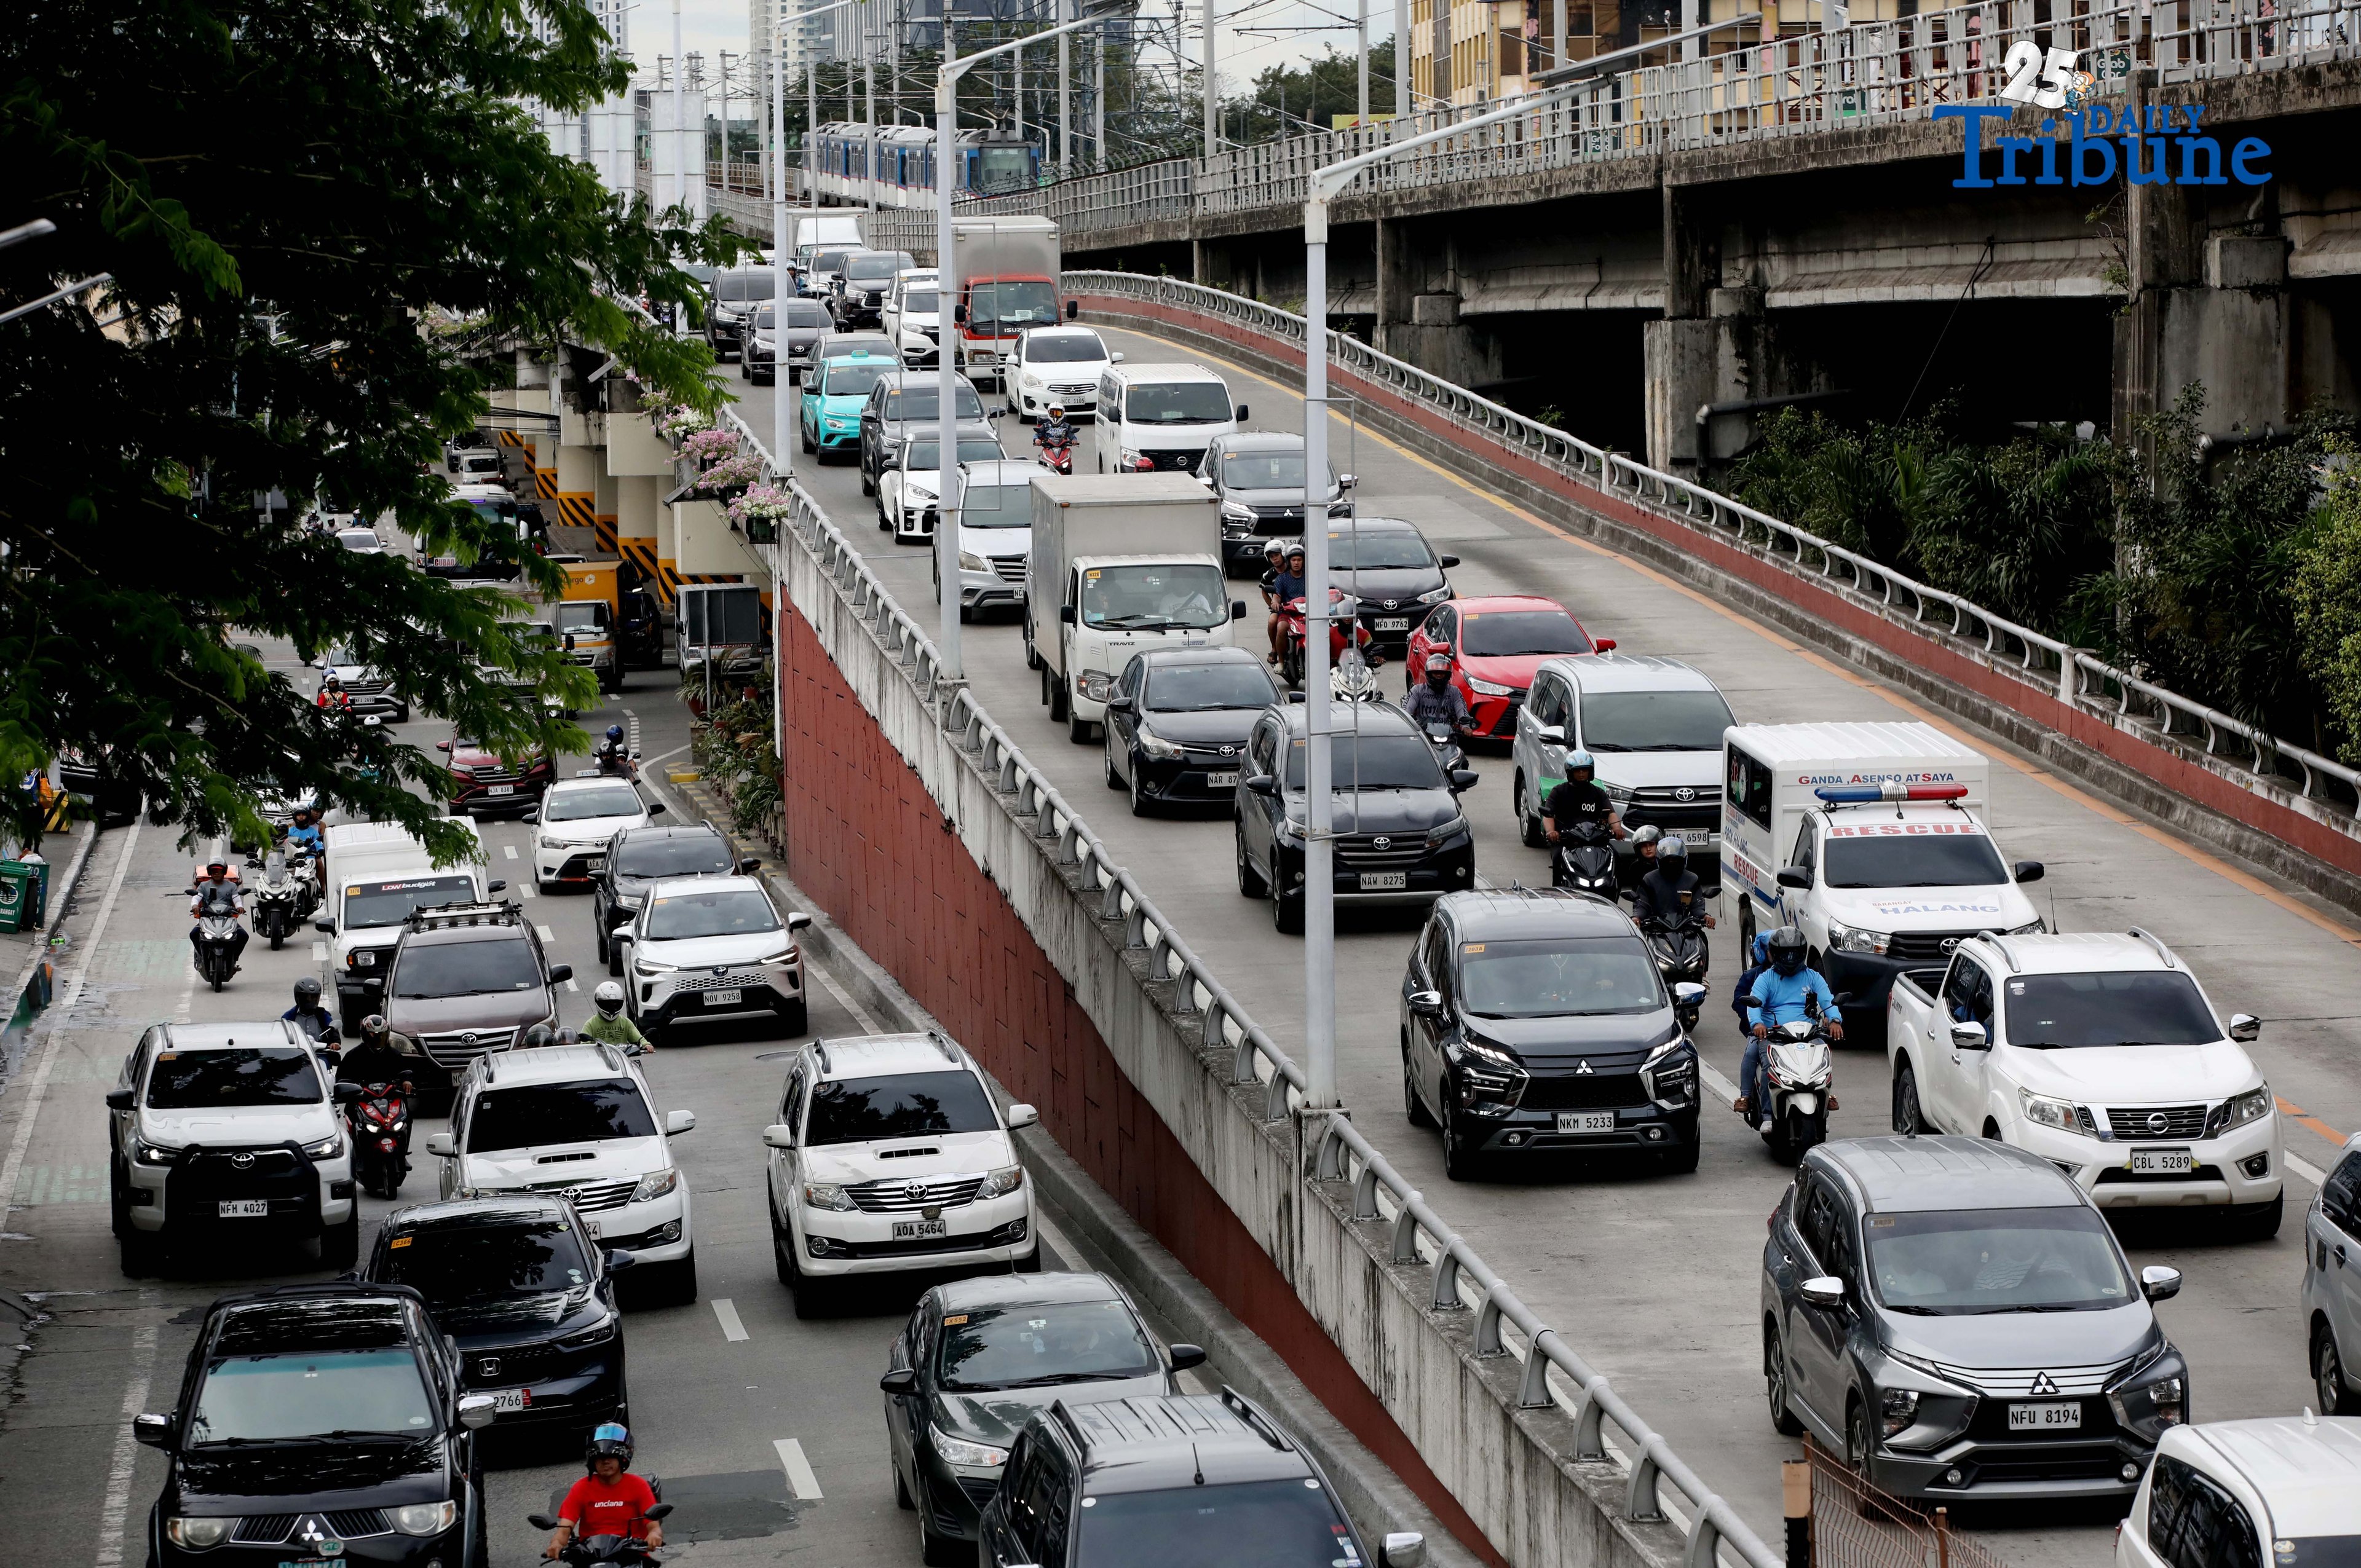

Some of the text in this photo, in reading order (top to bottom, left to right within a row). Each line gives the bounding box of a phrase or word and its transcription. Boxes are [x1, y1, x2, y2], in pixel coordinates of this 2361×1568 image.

[2097, 58, 2126, 69] Gab
[434, 558, 456, 567] CUBAO
[1208, 775, 1238, 784] NAR 87
[1832, 825, 1978, 837] RESCUE
[1687, 833, 1707, 842] 6598
[1734, 853, 1758, 886] RESCUE
[1361, 876, 1405, 886] NAW 8275
[1880, 905, 1999, 915] HALANG
[722, 993, 740, 1001] 9258
[1559, 1117, 1613, 1129] NKM 5233
[2134, 1156, 2190, 1169] CBL 5289
[220, 1203, 267, 1214] NFH 4027
[919, 1223, 943, 1235] 5464
[494, 1395, 521, 1408] 2766
[2011, 1409, 2079, 1424] NFU 8194
